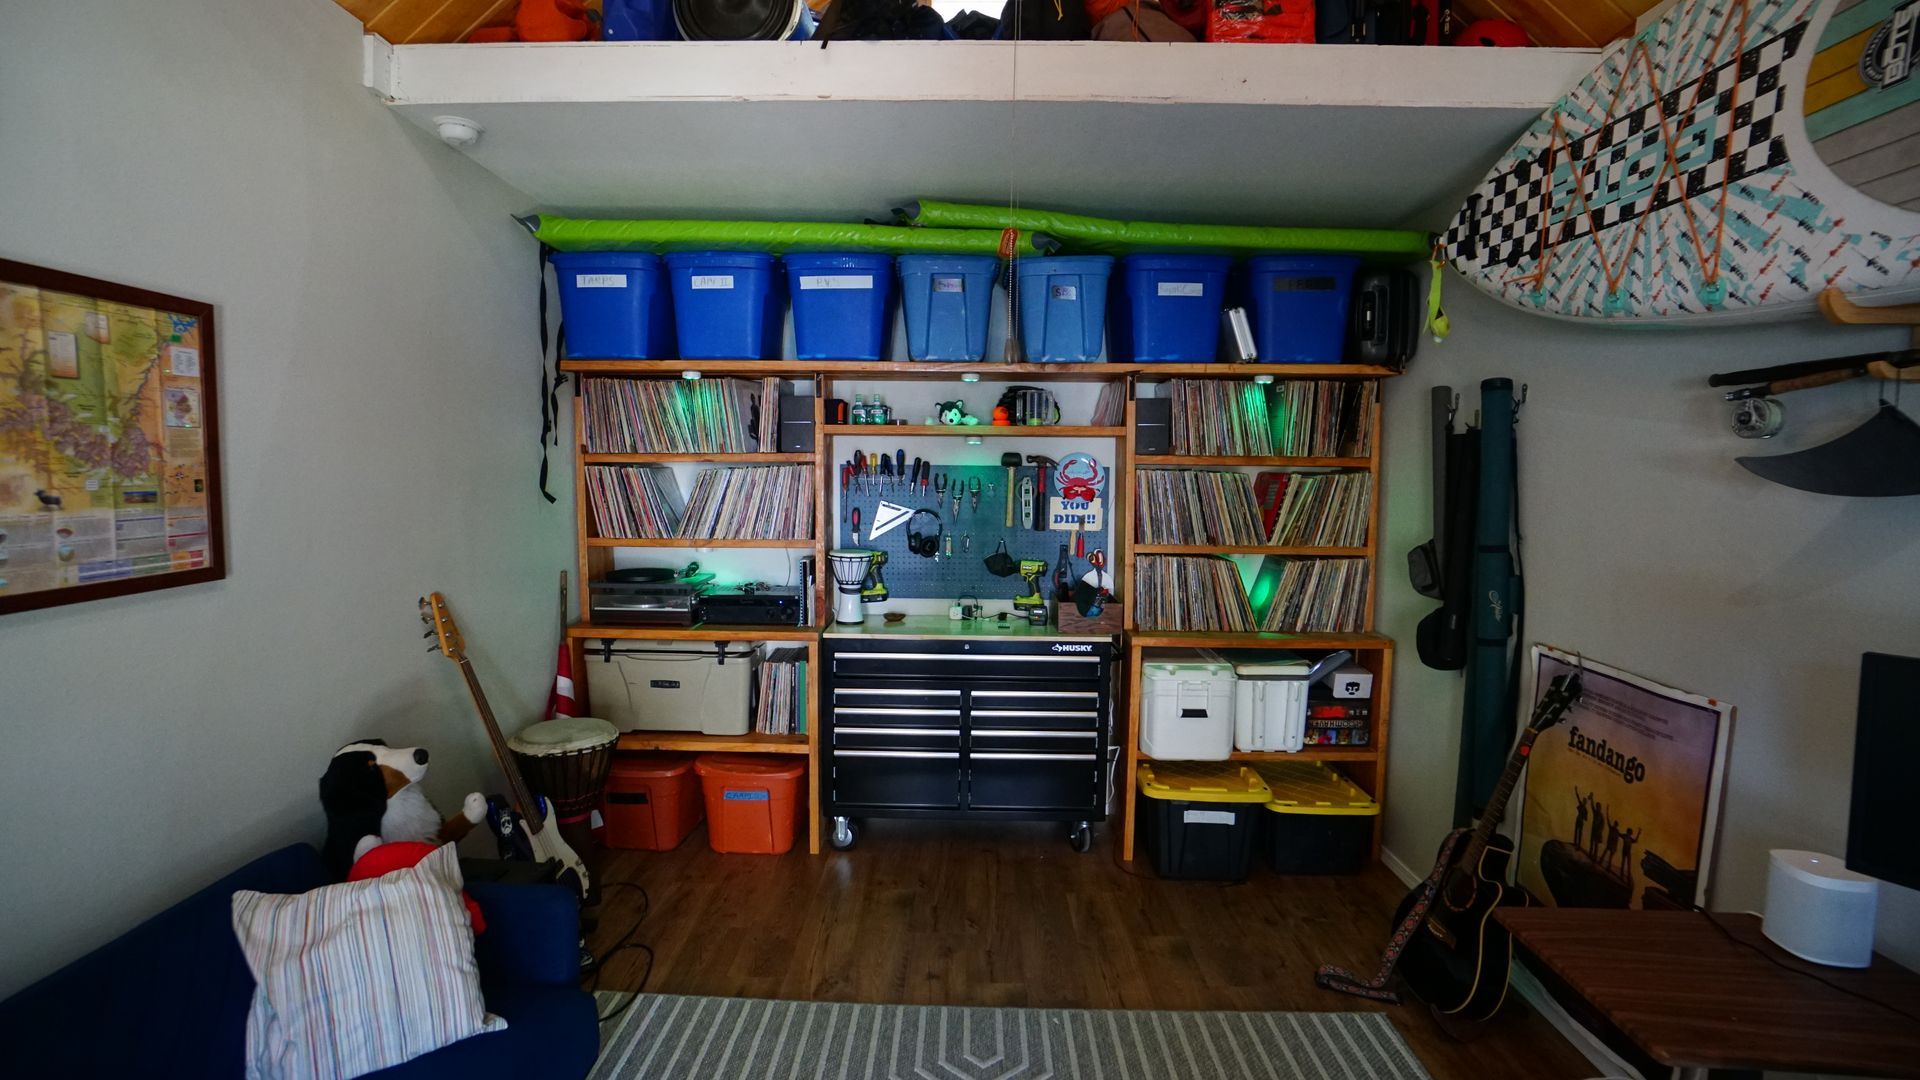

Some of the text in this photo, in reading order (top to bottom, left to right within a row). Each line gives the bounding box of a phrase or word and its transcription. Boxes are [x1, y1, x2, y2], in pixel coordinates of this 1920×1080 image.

[1061, 501, 1089, 510] YOU
[1062, 644, 1092, 652] HUSKY
[1567, 726, 1647, 784] fandango
